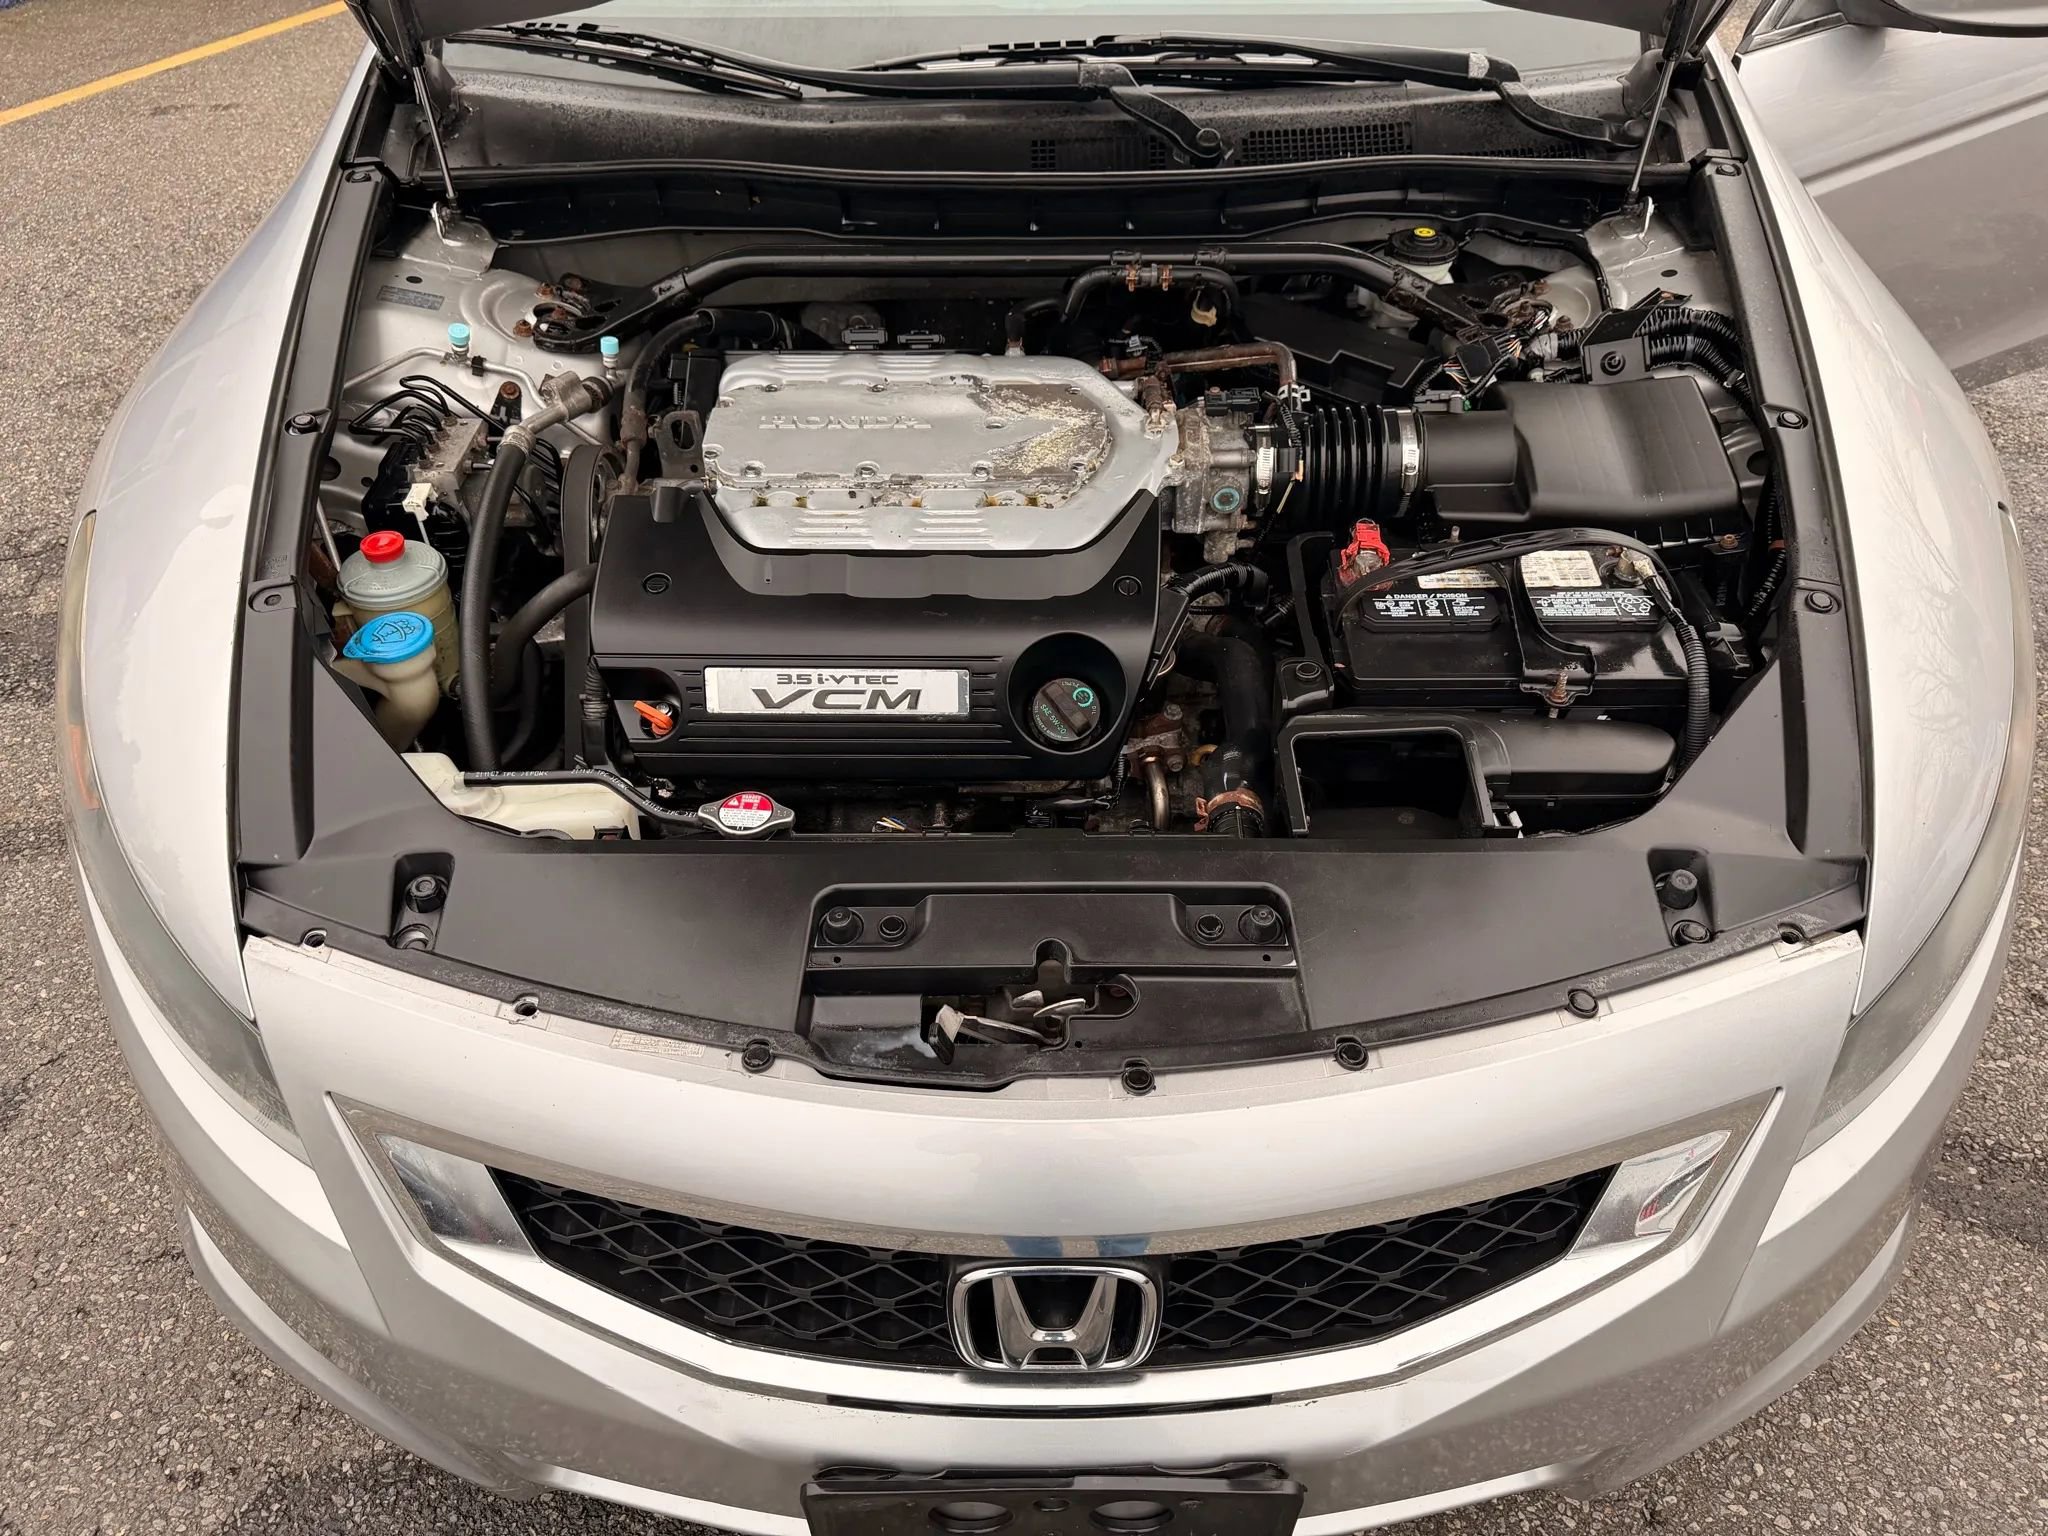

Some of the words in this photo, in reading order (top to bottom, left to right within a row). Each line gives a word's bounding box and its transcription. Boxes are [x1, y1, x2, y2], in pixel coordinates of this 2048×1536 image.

[759, 415, 931, 429] HONDA
[777, 673, 812, 685] 3.5
[817, 673, 898, 685] i-VTEC
[752, 688, 922, 710] VCM
[1040, 704, 1052, 717] SAE
